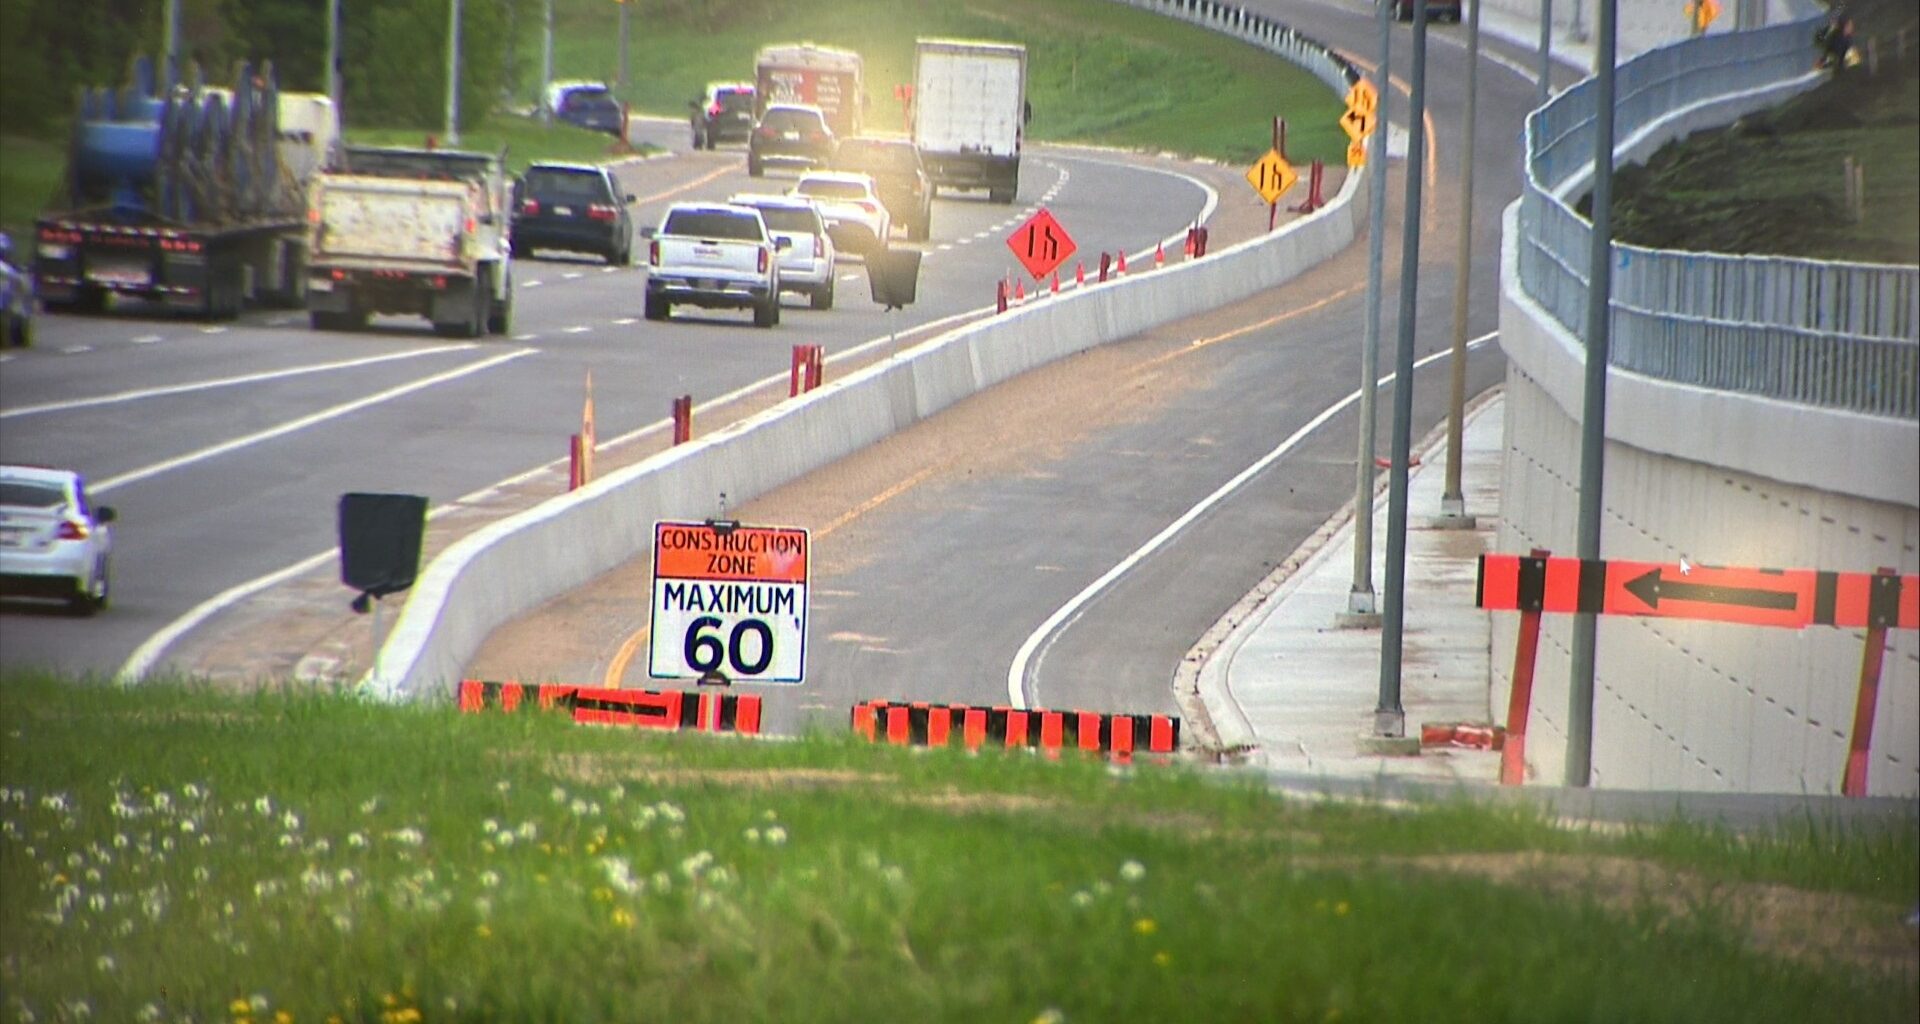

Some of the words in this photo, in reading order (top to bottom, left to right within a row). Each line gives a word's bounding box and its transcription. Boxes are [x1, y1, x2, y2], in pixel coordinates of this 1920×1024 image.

[661, 530, 802, 555] CONSTRUCTION
[707, 553, 756, 575] ZONE
[664, 583, 794, 615] MAXIMUM
[684, 616, 774, 675] 60
